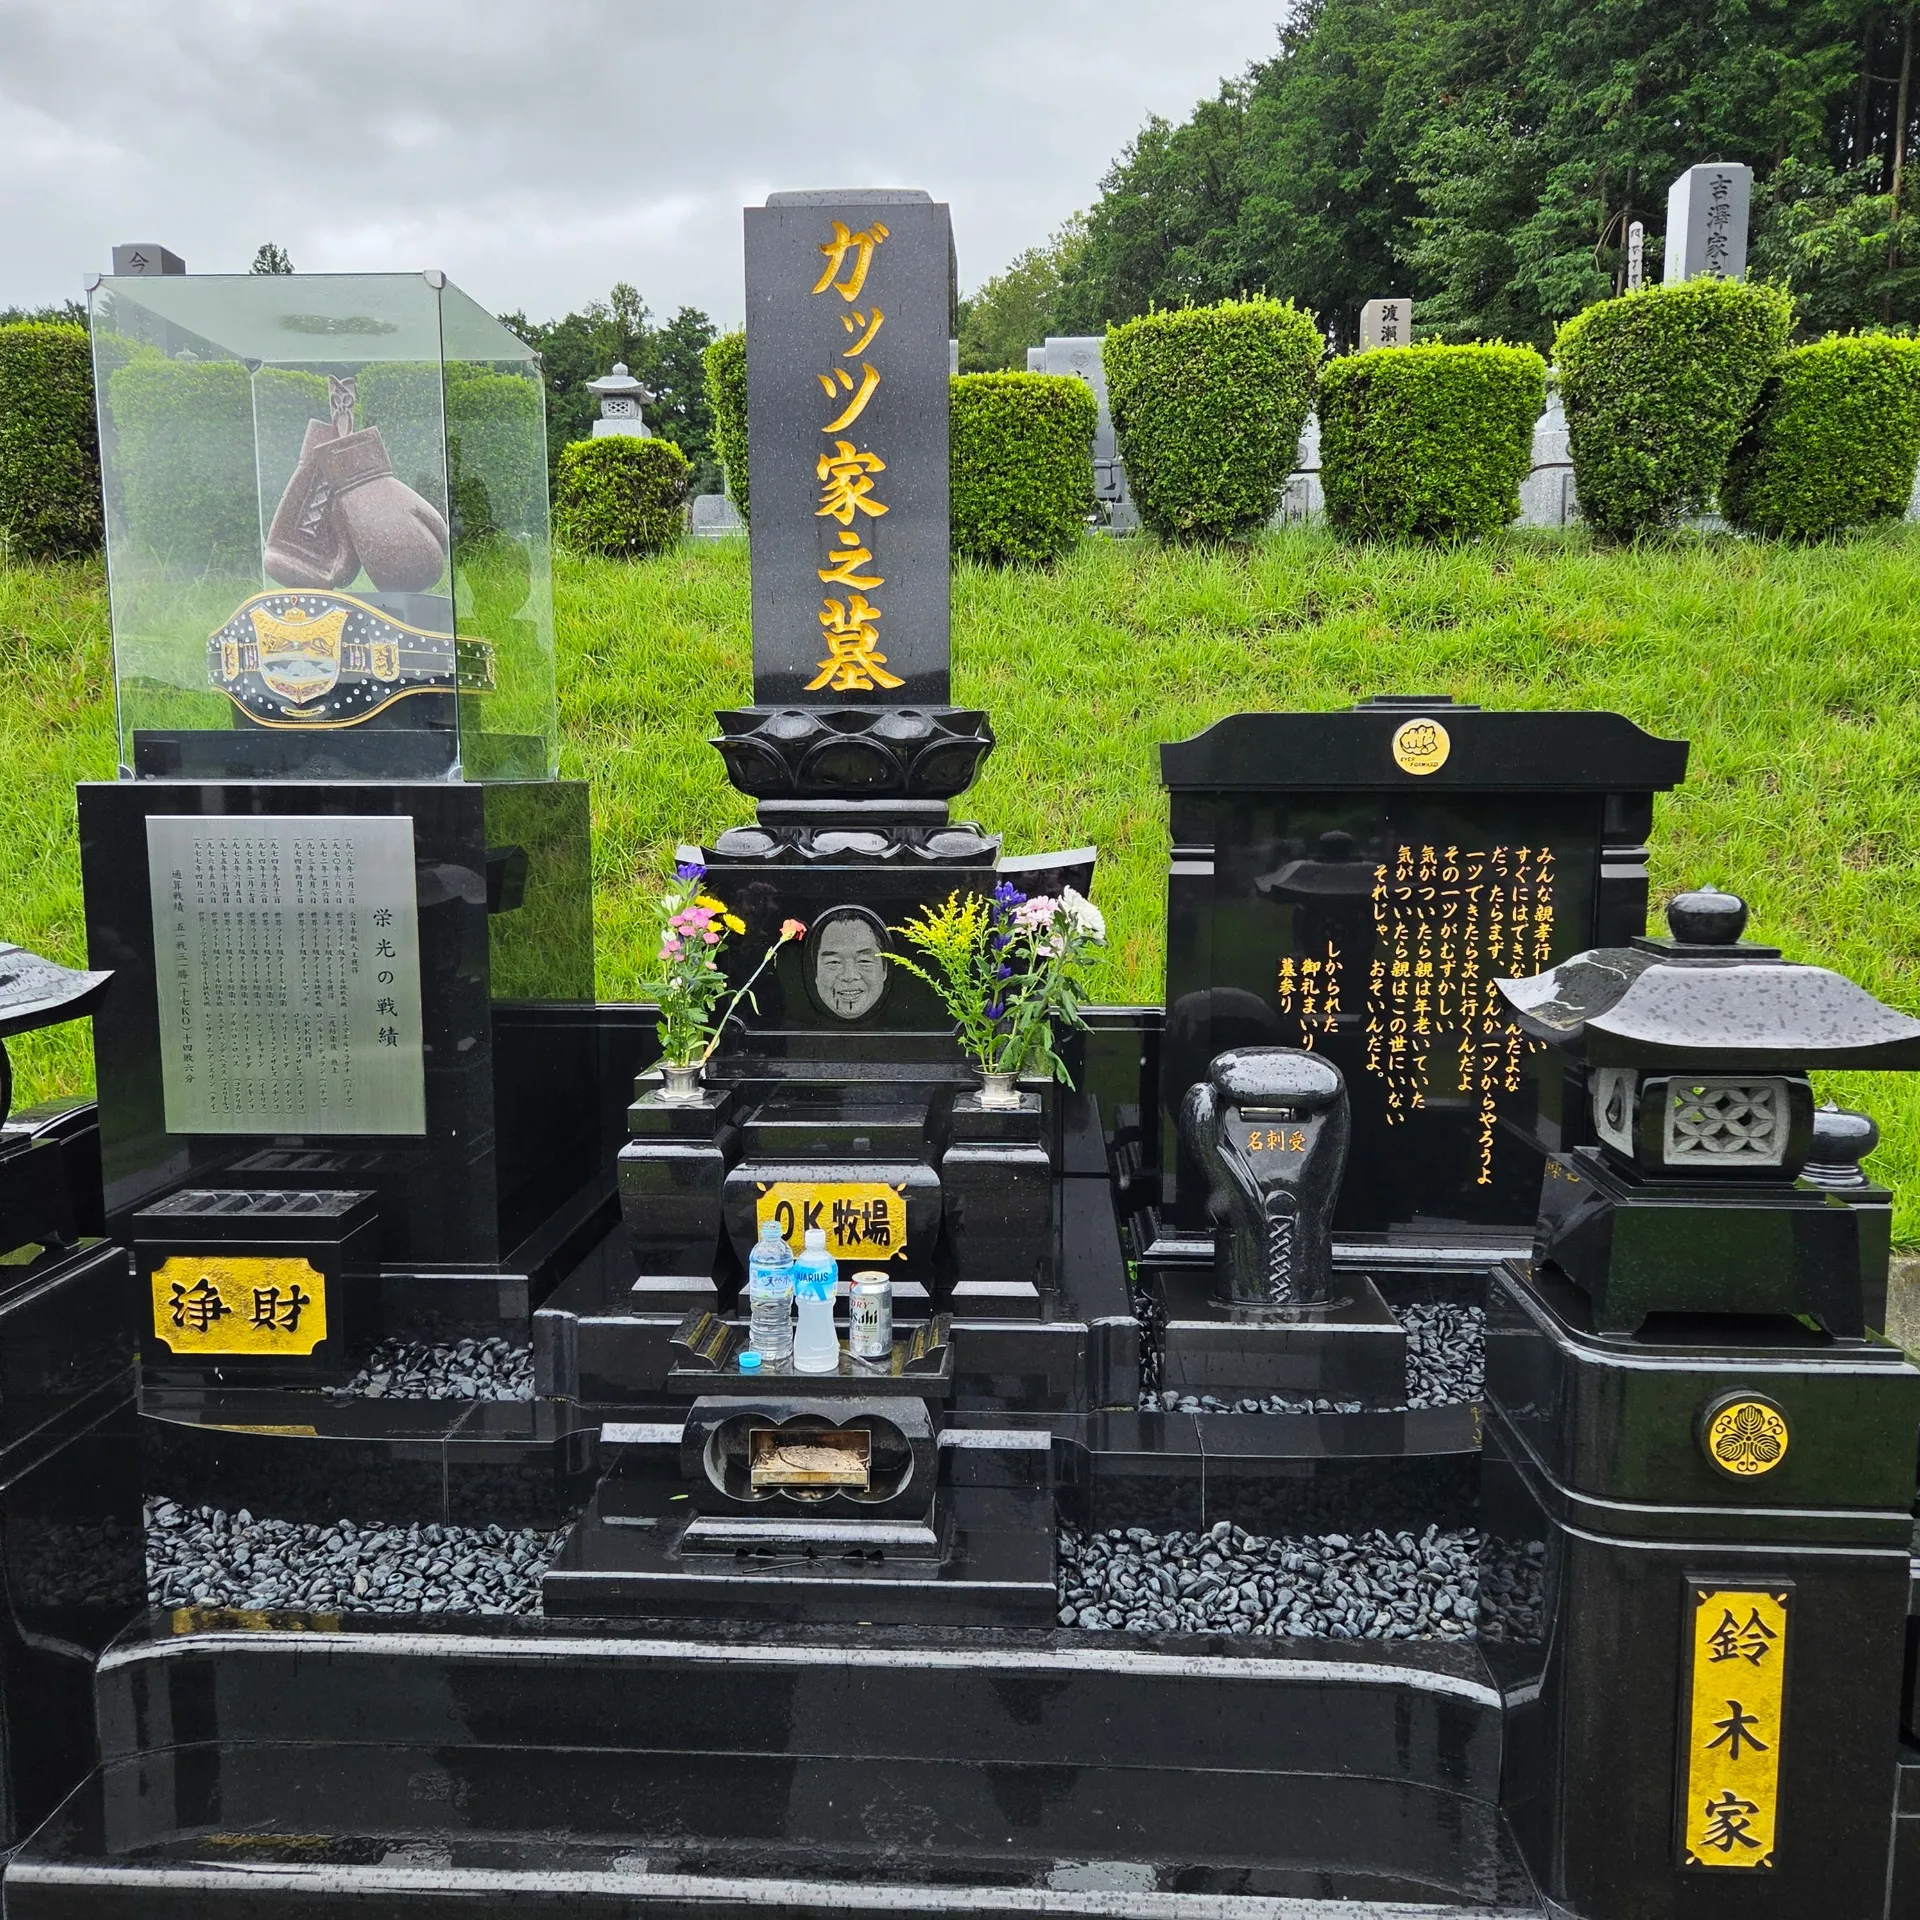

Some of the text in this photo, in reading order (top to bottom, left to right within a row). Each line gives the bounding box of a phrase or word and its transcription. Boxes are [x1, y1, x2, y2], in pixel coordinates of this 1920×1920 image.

[128, 251, 150, 273] 今
[804, 219, 906, 692] ガッツ家之墓
[373, 907, 400, 1048] 栄光の戦績
[1278, 959, 1298, 1014] 墓参り
[1323, 940, 1343, 1034] しかられた
[1386, 844, 1414, 1126] 気がついたら親はこの世にいない
[1410, 844, 1438, 1110] 気がついたら親は年老いていた
[1434, 846, 1460, 1035] その一ツがむずかしい
[1457, 850, 1486, 1091] 一ツできたら次に行くんだよ
[1299, 959, 1321, 1052] 御礼まいり
[1247, 1130, 1306, 1152] 名刺受
[169, 1277, 310, 1333] 浄財
[794, 1270, 829, 1283] QUARIUS
[1700, 1607, 1777, 1854] 鈴木家
